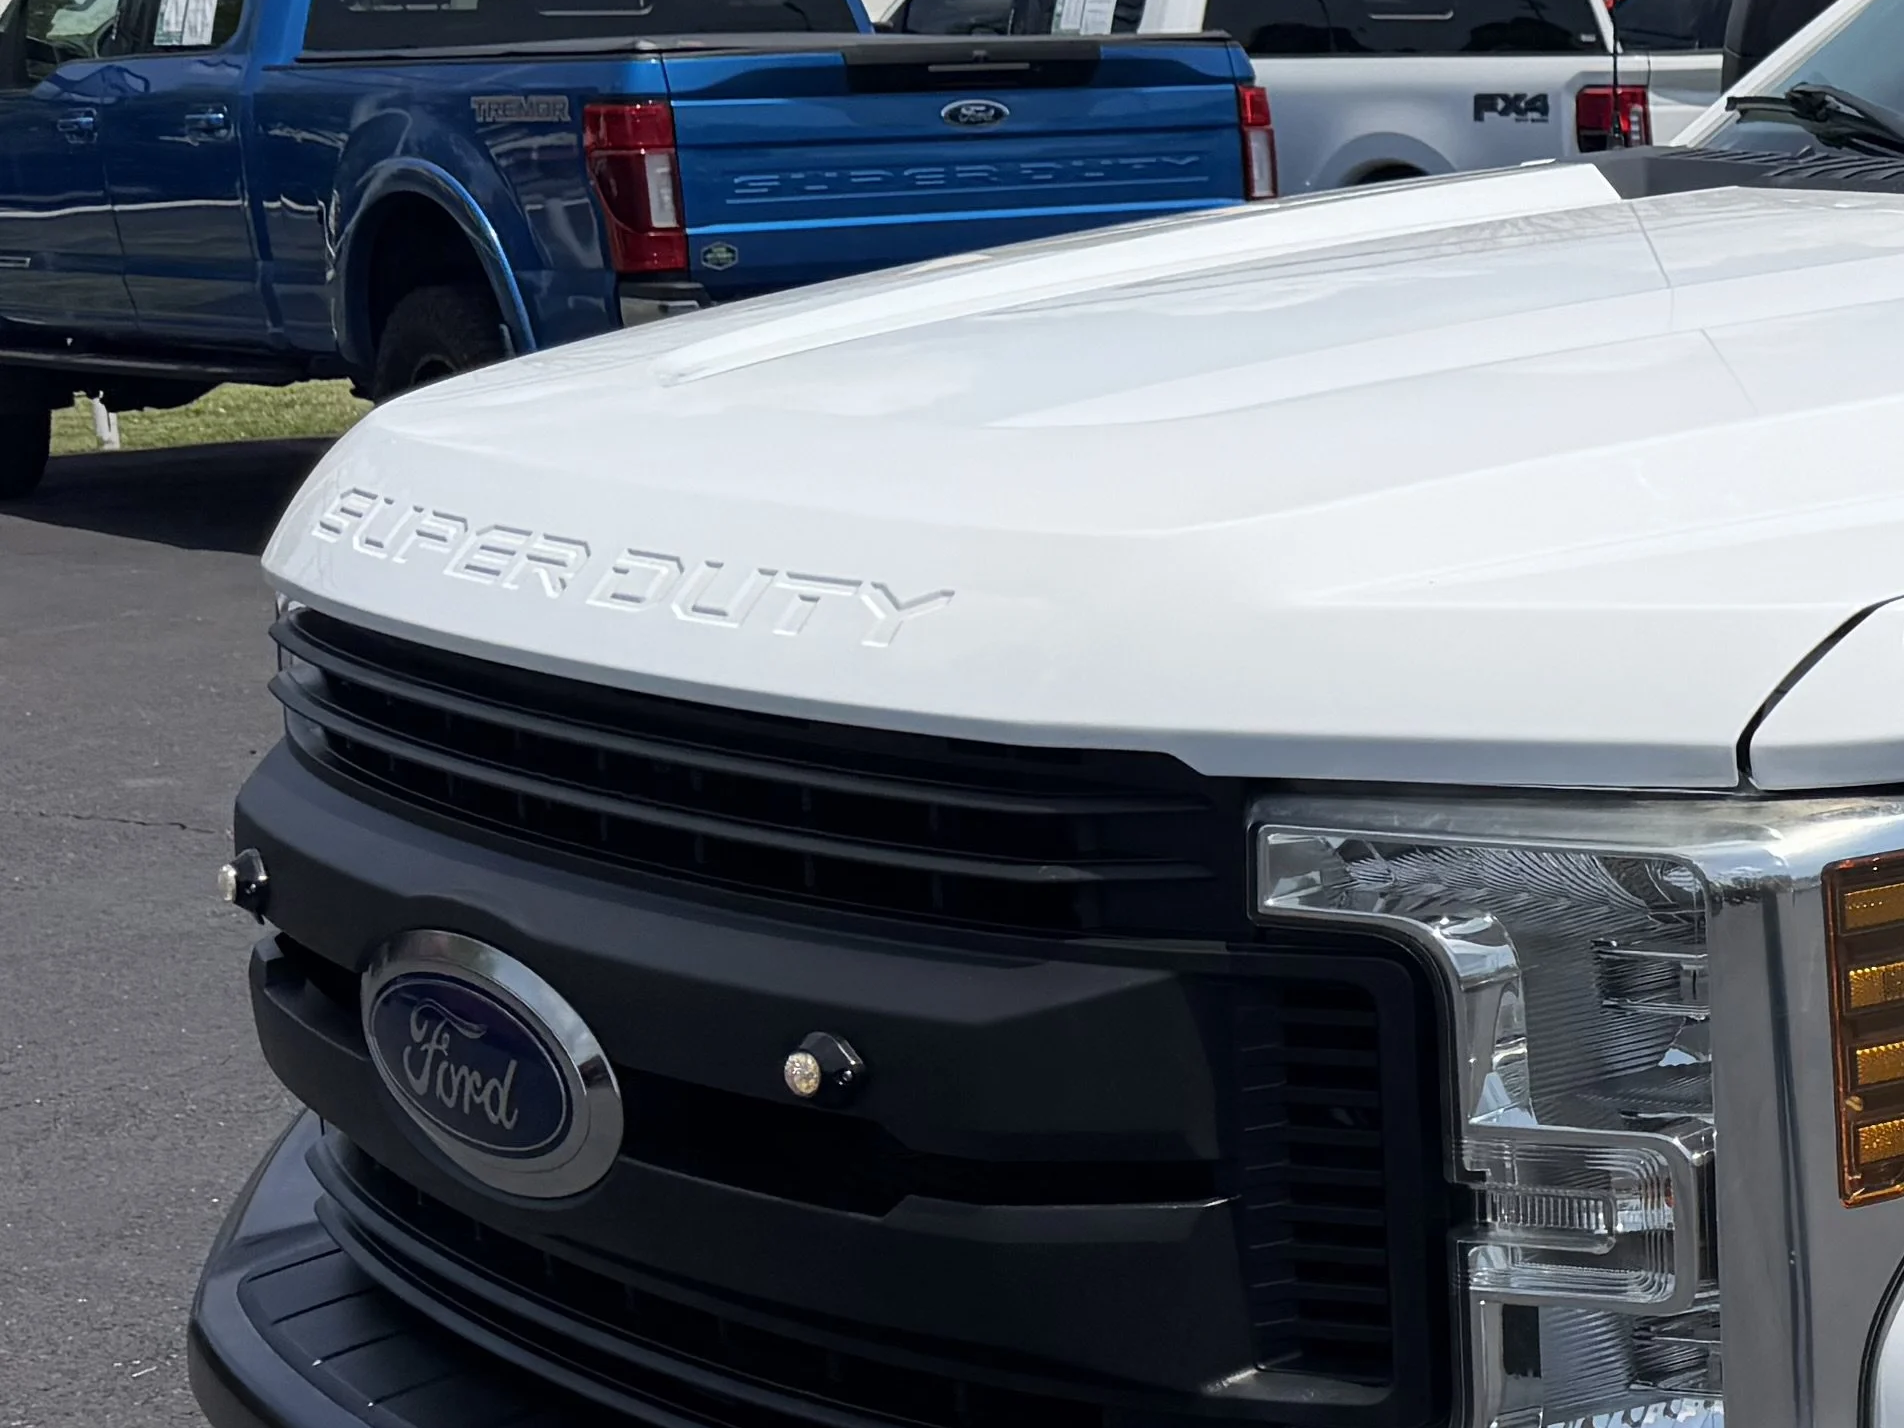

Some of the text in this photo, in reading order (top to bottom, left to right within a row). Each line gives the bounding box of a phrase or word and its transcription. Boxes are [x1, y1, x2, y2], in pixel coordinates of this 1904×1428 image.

[470, 95, 571, 123] TREMOR
[1473, 93, 1549, 122] FX4
[734, 156, 1199, 193] SUPER DUTY
[312, 487, 956, 649] SUPER DUTY
[404, 996, 519, 1130] Ford
